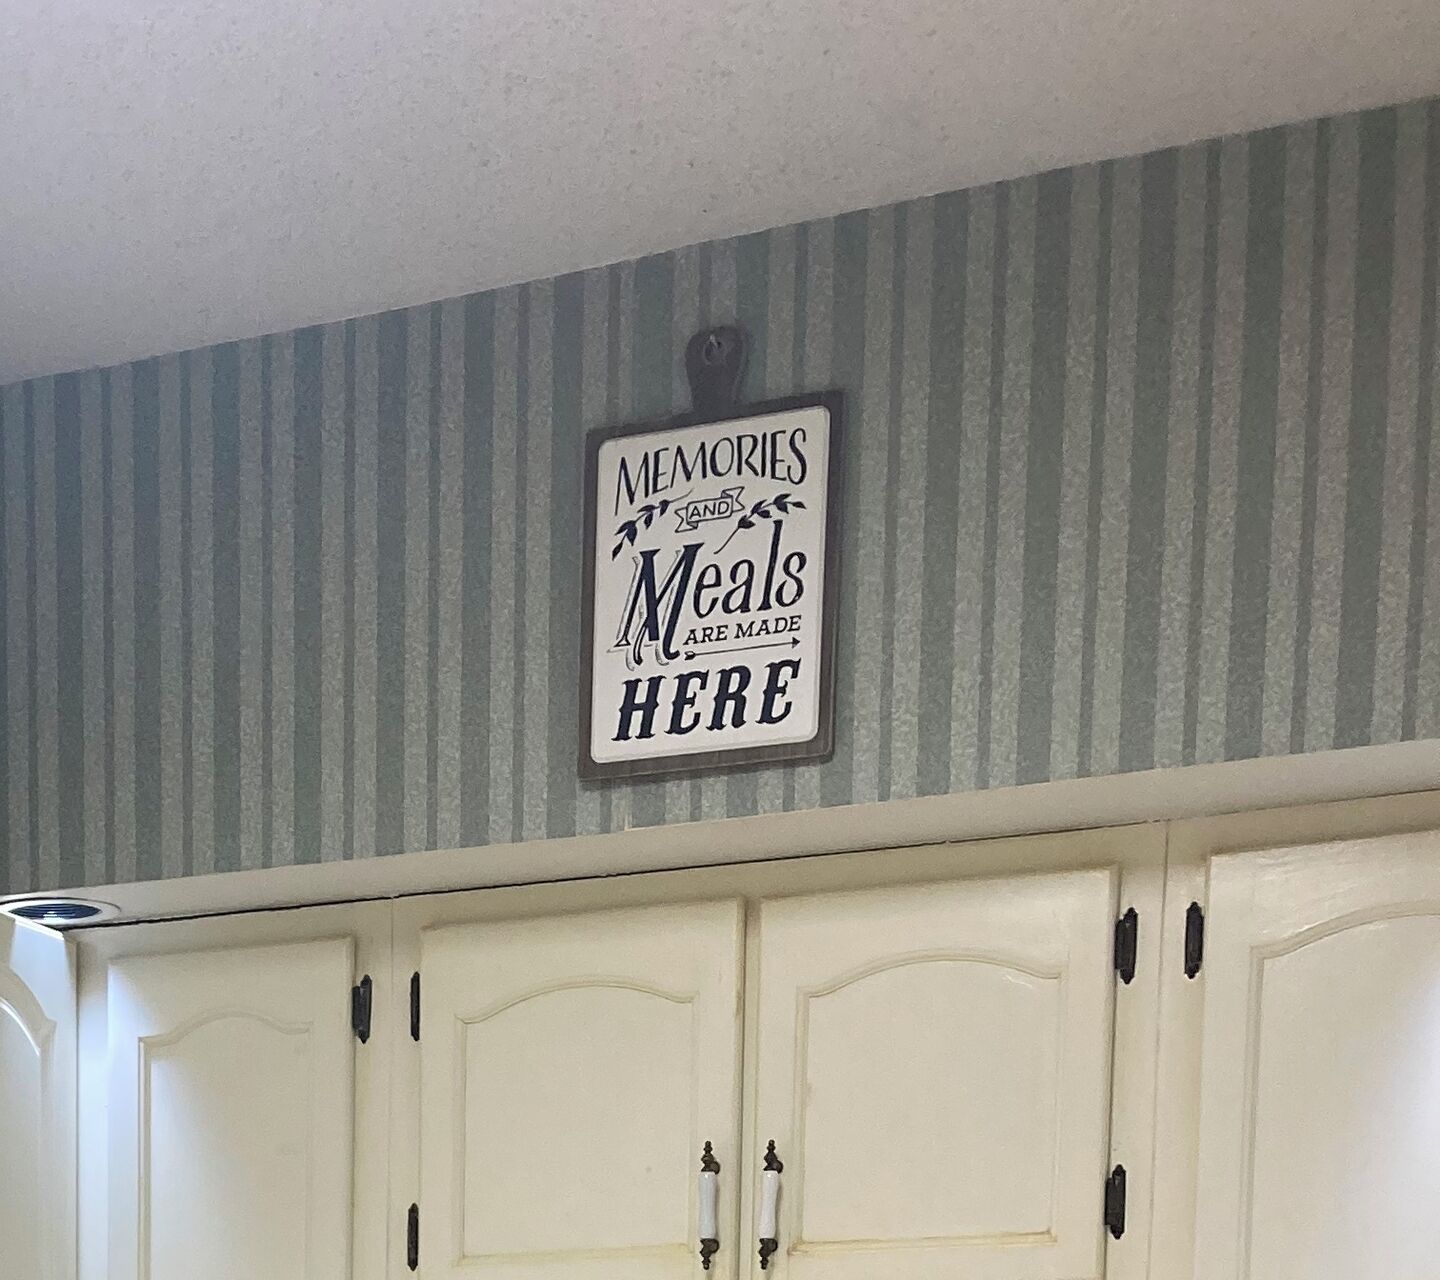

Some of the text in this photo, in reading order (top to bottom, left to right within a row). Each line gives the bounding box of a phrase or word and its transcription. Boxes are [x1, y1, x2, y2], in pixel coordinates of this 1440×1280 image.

[614, 427, 808, 516] MEMORIES
[688, 500, 731, 521] AND
[610, 519, 808, 668] Meals
[682, 614, 803, 646] ARE MADE
[610, 657, 803, 742] HERE
